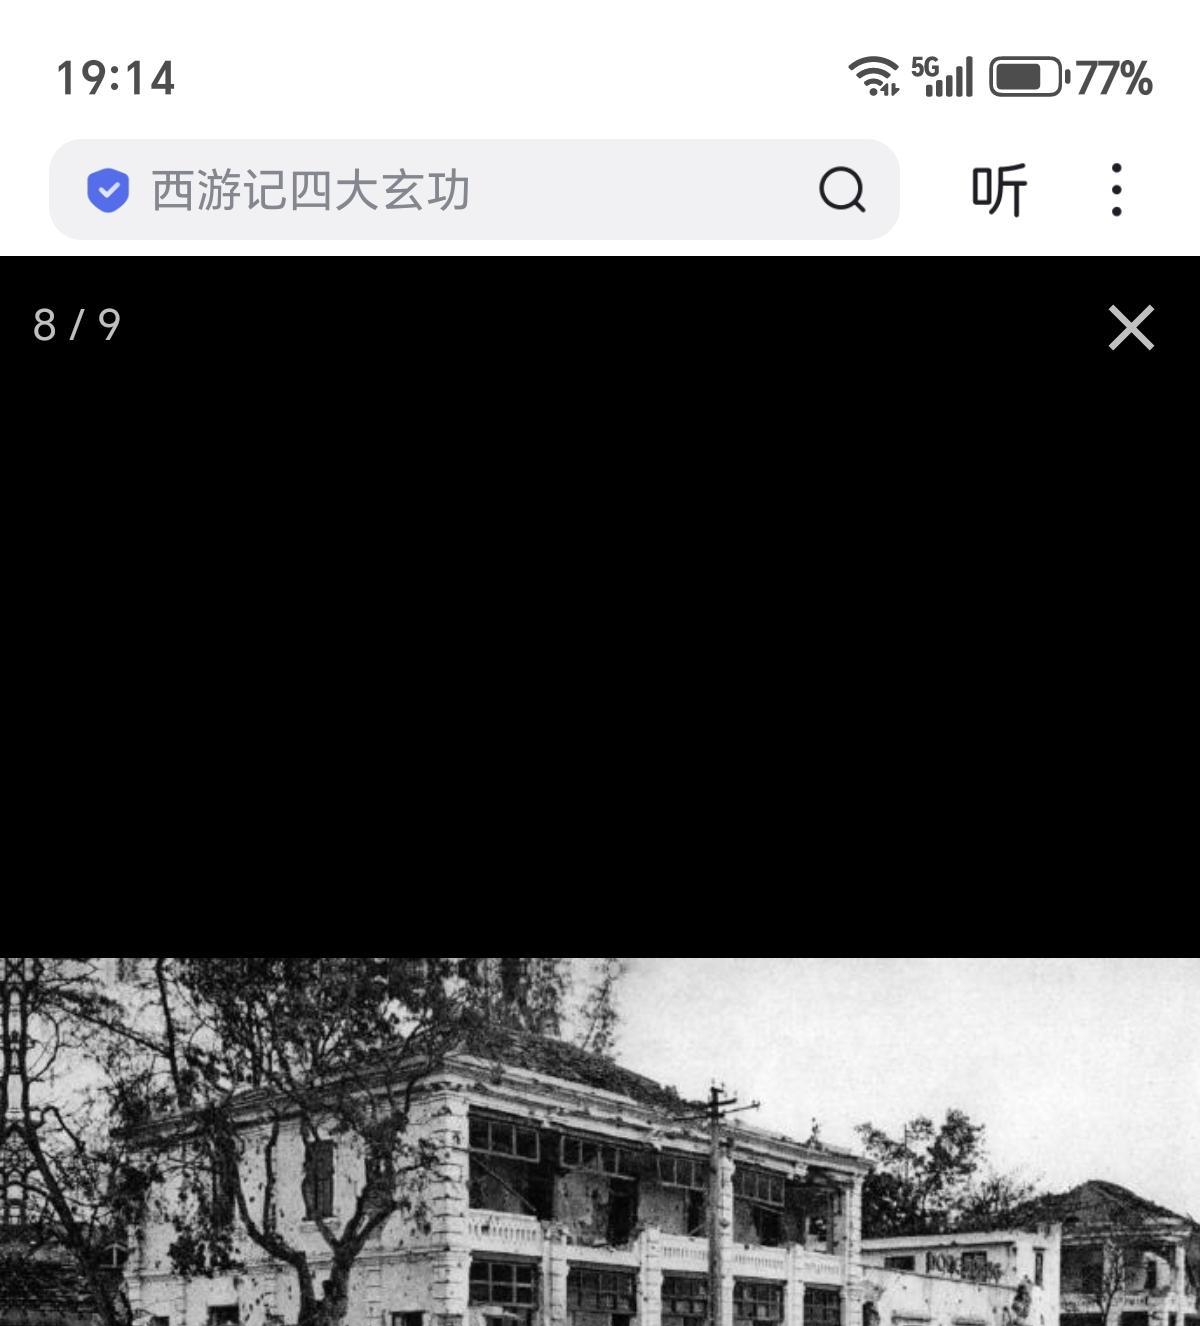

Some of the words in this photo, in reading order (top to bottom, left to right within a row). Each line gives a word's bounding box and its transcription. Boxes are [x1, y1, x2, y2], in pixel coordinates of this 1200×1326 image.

[57, 60, 175, 96] 19:14
[911, 56, 940, 78] 5G
[1075, 59, 1154, 96] 77%
[152, 167, 470, 212] 西游记四大玄功
[972, 162, 1028, 218] 听
